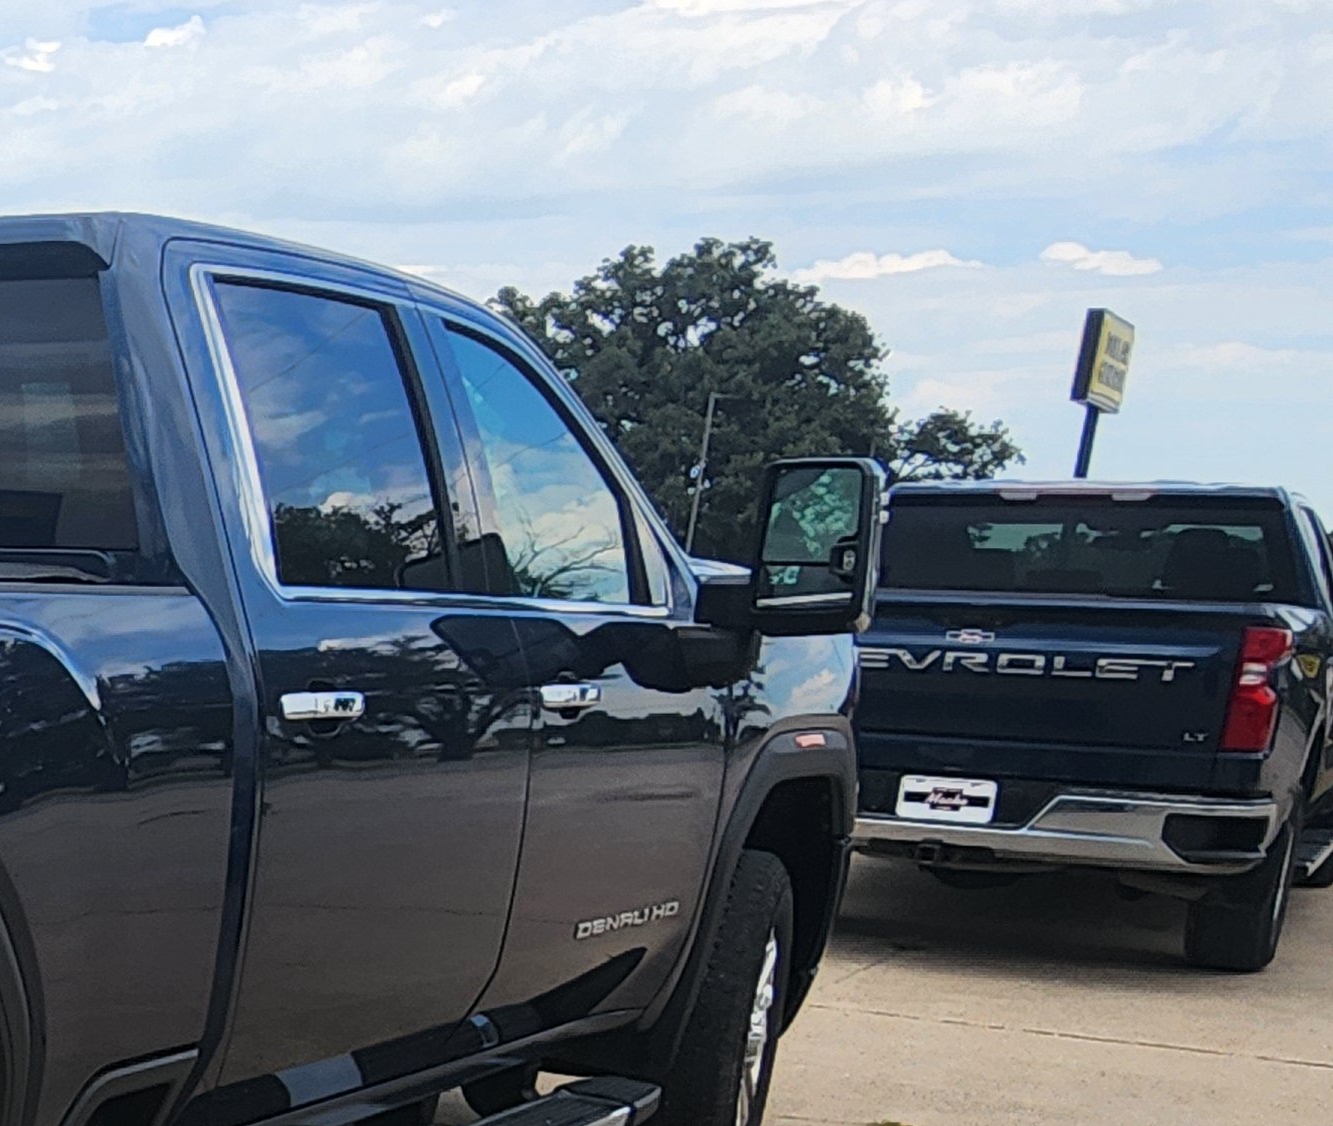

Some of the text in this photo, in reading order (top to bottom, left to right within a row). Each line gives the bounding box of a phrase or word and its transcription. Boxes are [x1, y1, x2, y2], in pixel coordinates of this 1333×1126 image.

[1182, 731, 1209, 743] LT
[575, 901, 680, 940] DENALI HD
